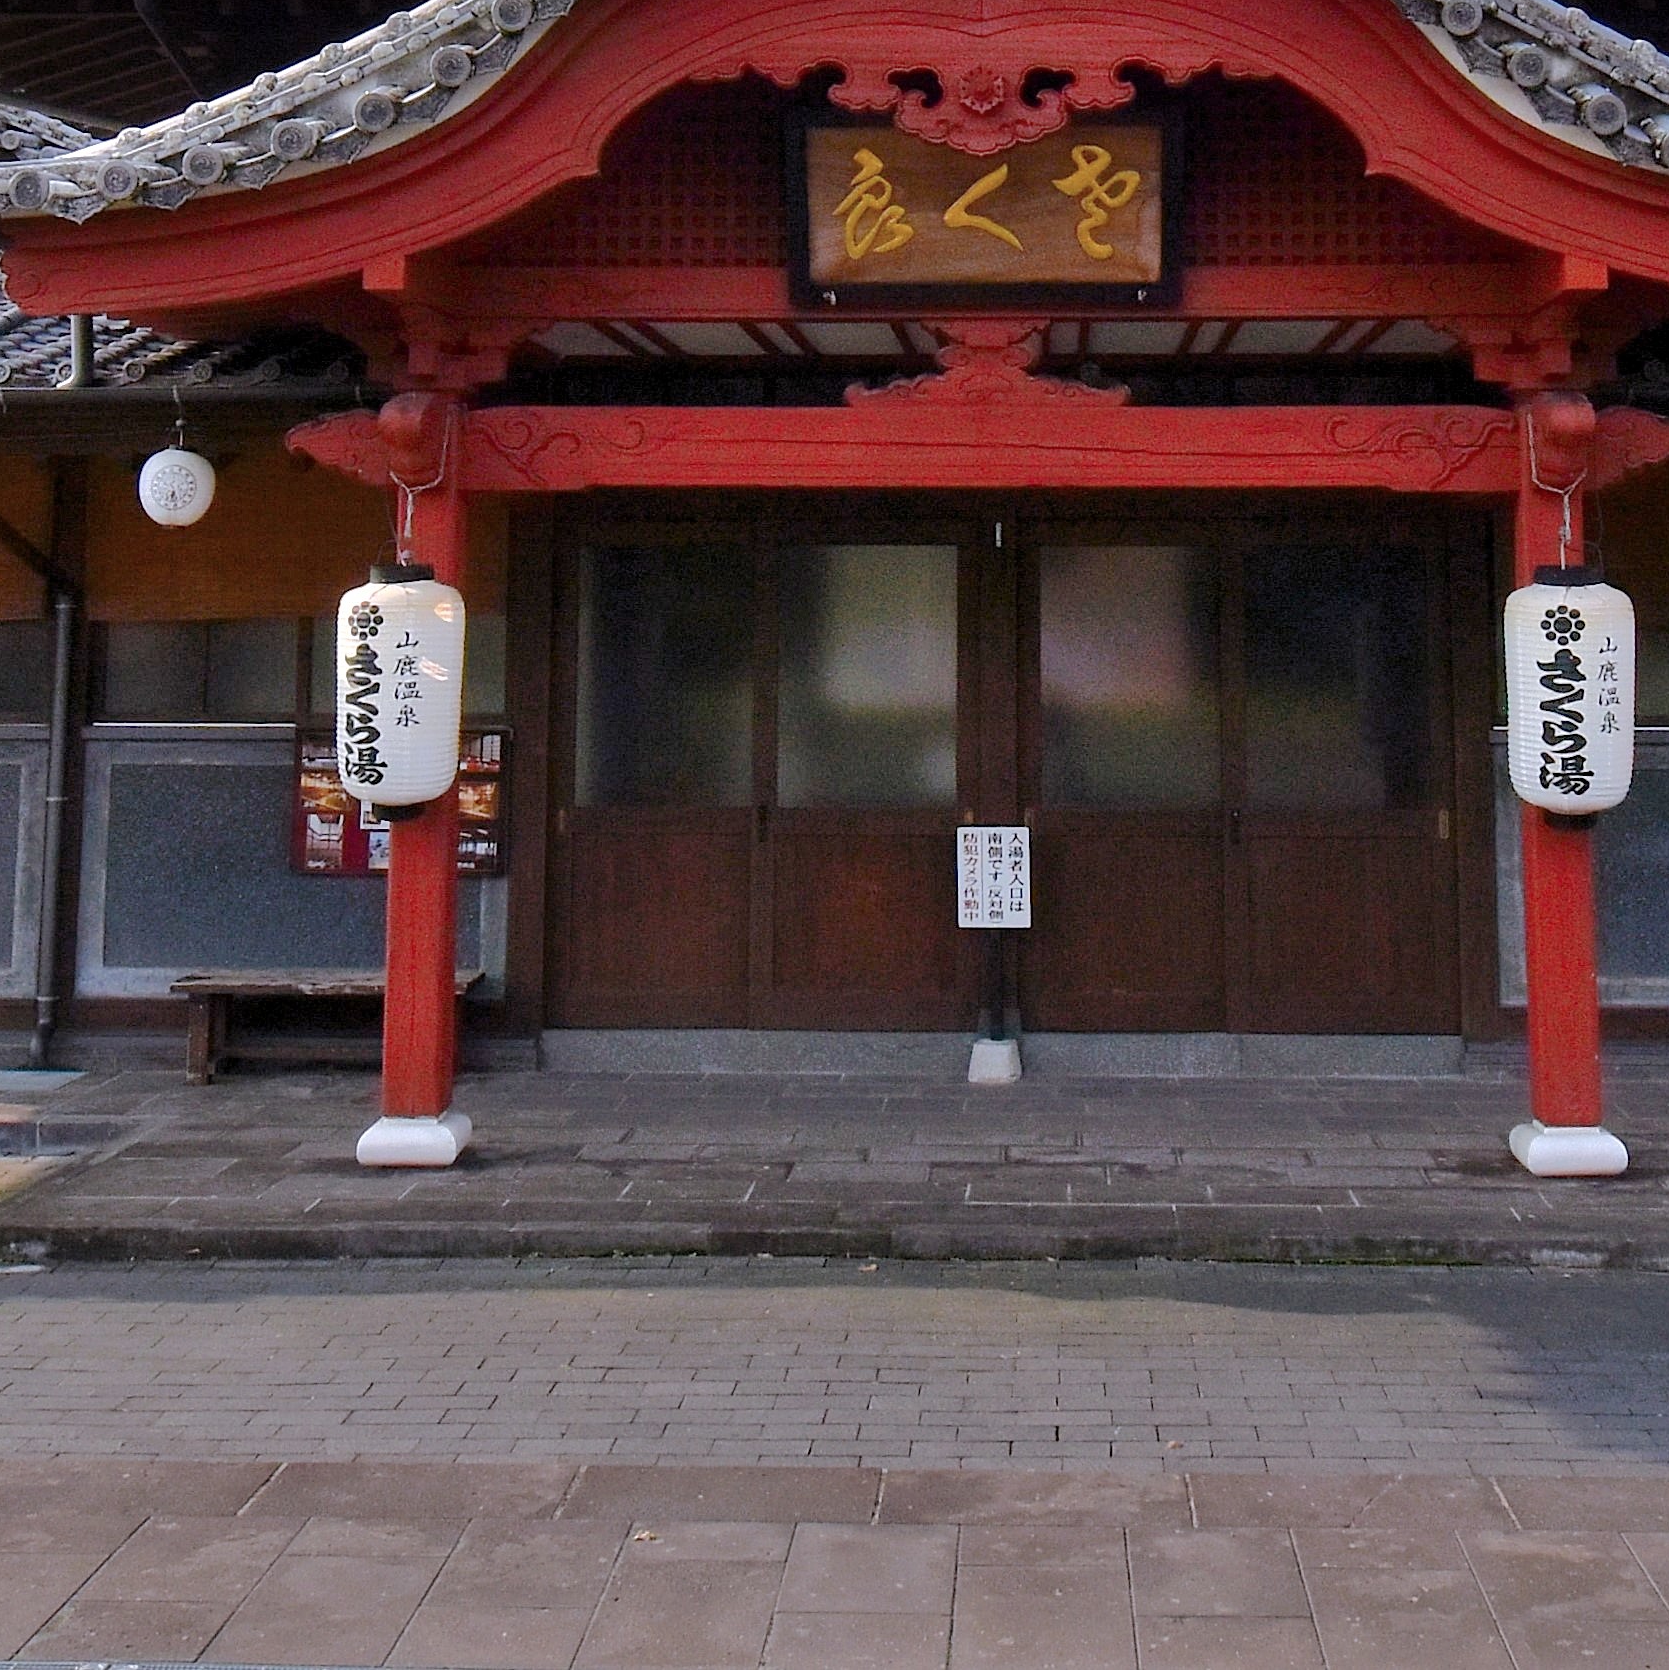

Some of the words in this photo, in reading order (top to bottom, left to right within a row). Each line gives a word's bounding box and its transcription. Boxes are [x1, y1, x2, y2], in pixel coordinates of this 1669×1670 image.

[344, 642, 388, 786] さくら湯
[393, 631, 423, 728] 山鹿温泉
[1536, 649, 1594, 795] さくら湯
[1597, 636, 1622, 735] 山鹿温泉
[963, 833, 979, 922] 防犯カメラ作動中
[1009, 833, 1024, 912] 入湯者入口は
